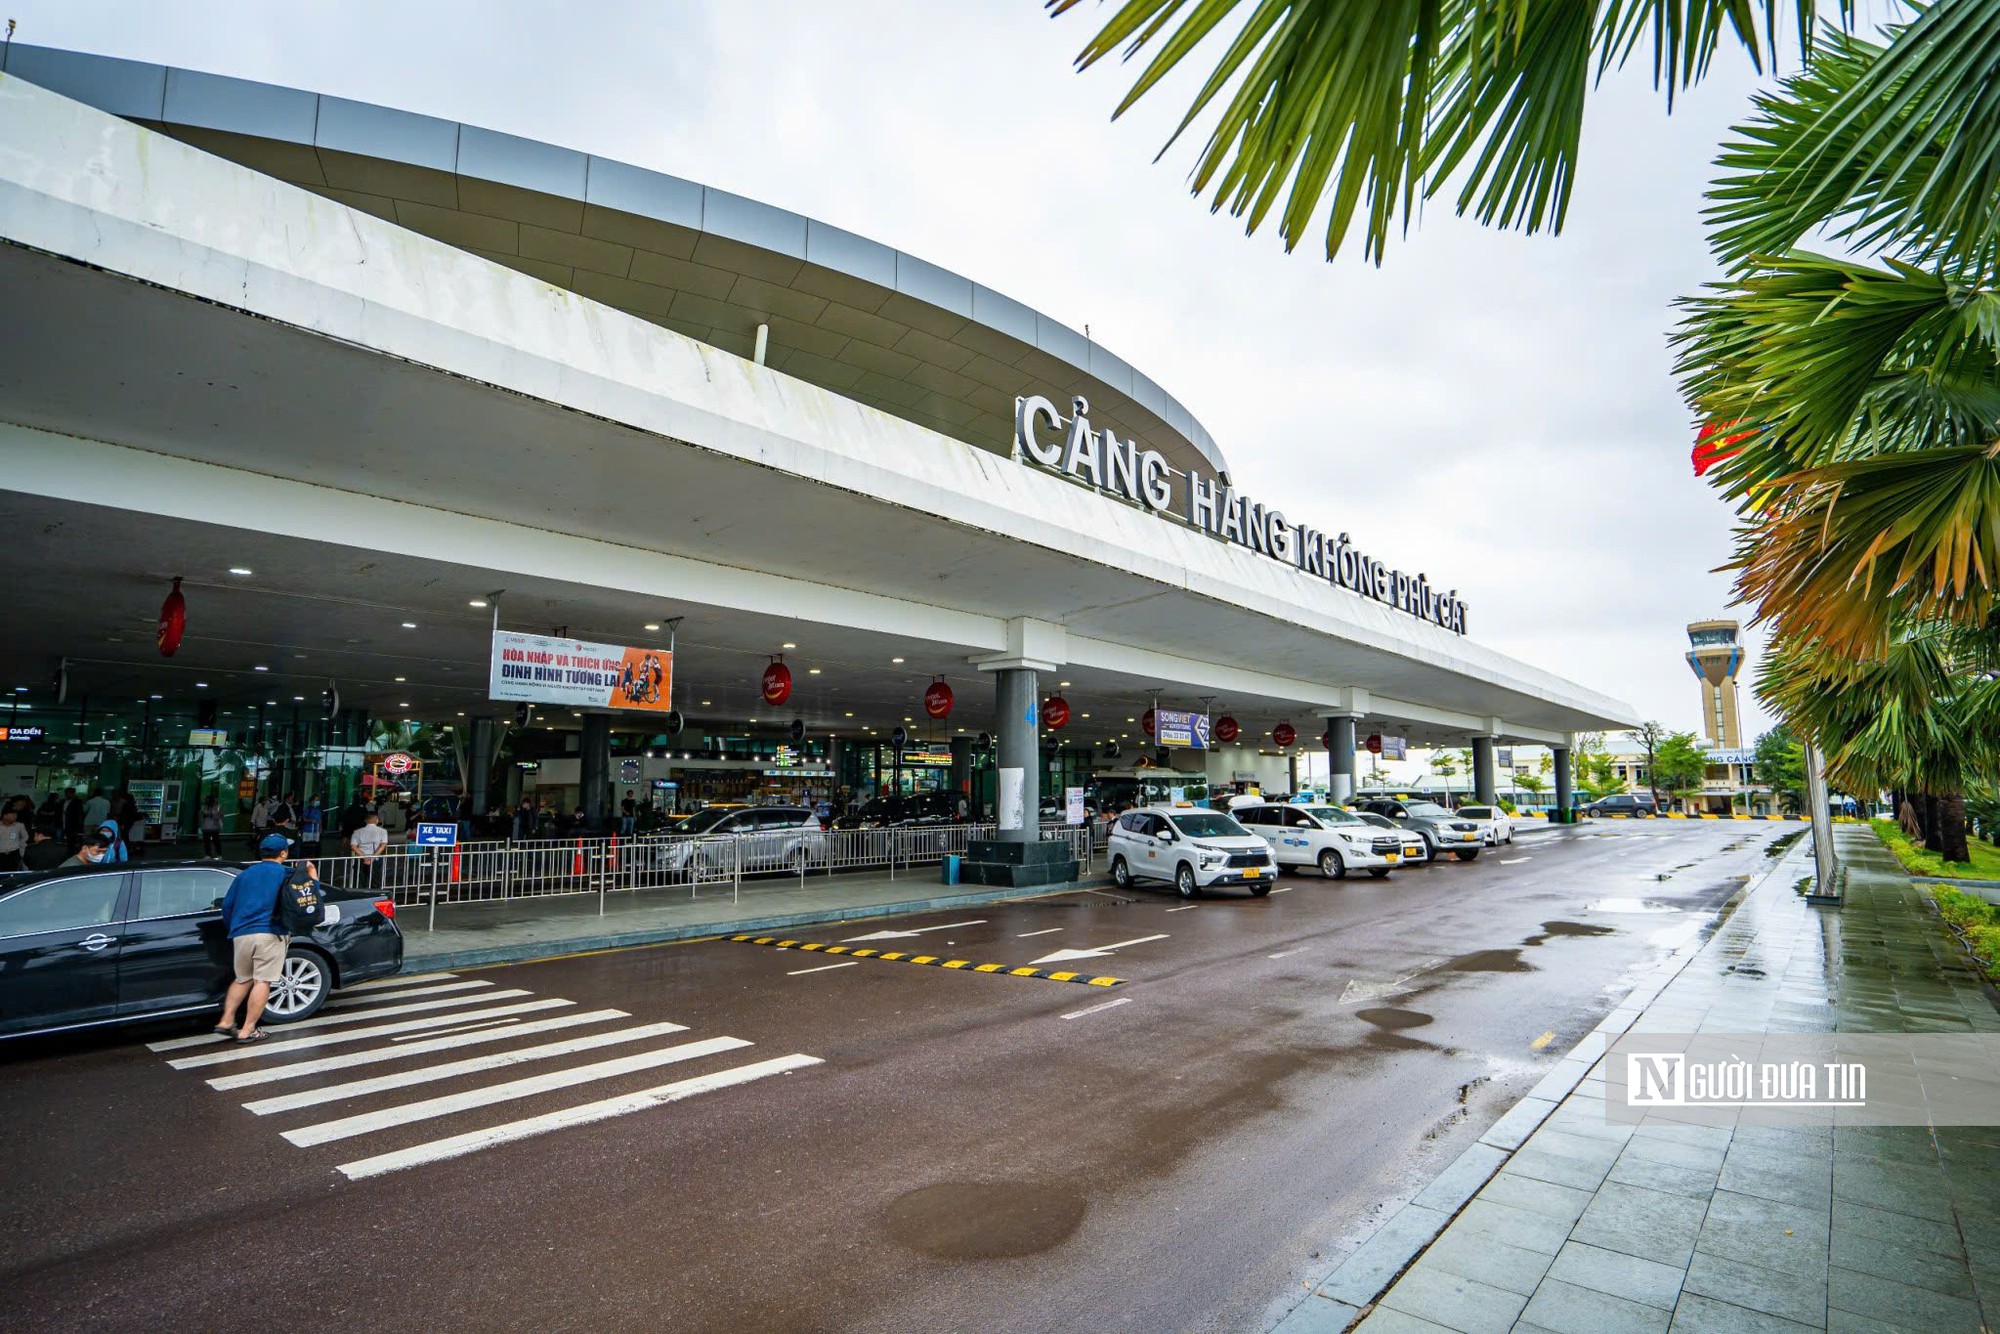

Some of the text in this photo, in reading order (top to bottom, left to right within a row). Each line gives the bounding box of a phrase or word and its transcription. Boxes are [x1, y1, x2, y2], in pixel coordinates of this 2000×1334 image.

[1018, 395, 1171, 511] CẢNG
[1186, 470, 1289, 560] HÀNG
[1298, 524, 1388, 600] KHÔNG
[1436, 590, 1469, 635] CÁT
[503, 648, 524, 662] HÒA
[556, 653, 569, 667] VÀ
[571, 655, 599, 670] THÍCH
[534, 664, 563, 683] HÌNH
[604, 673, 620, 688] LAI
[422, 826, 452, 834] XE TAXI
[299, 886, 312, 897] 12
